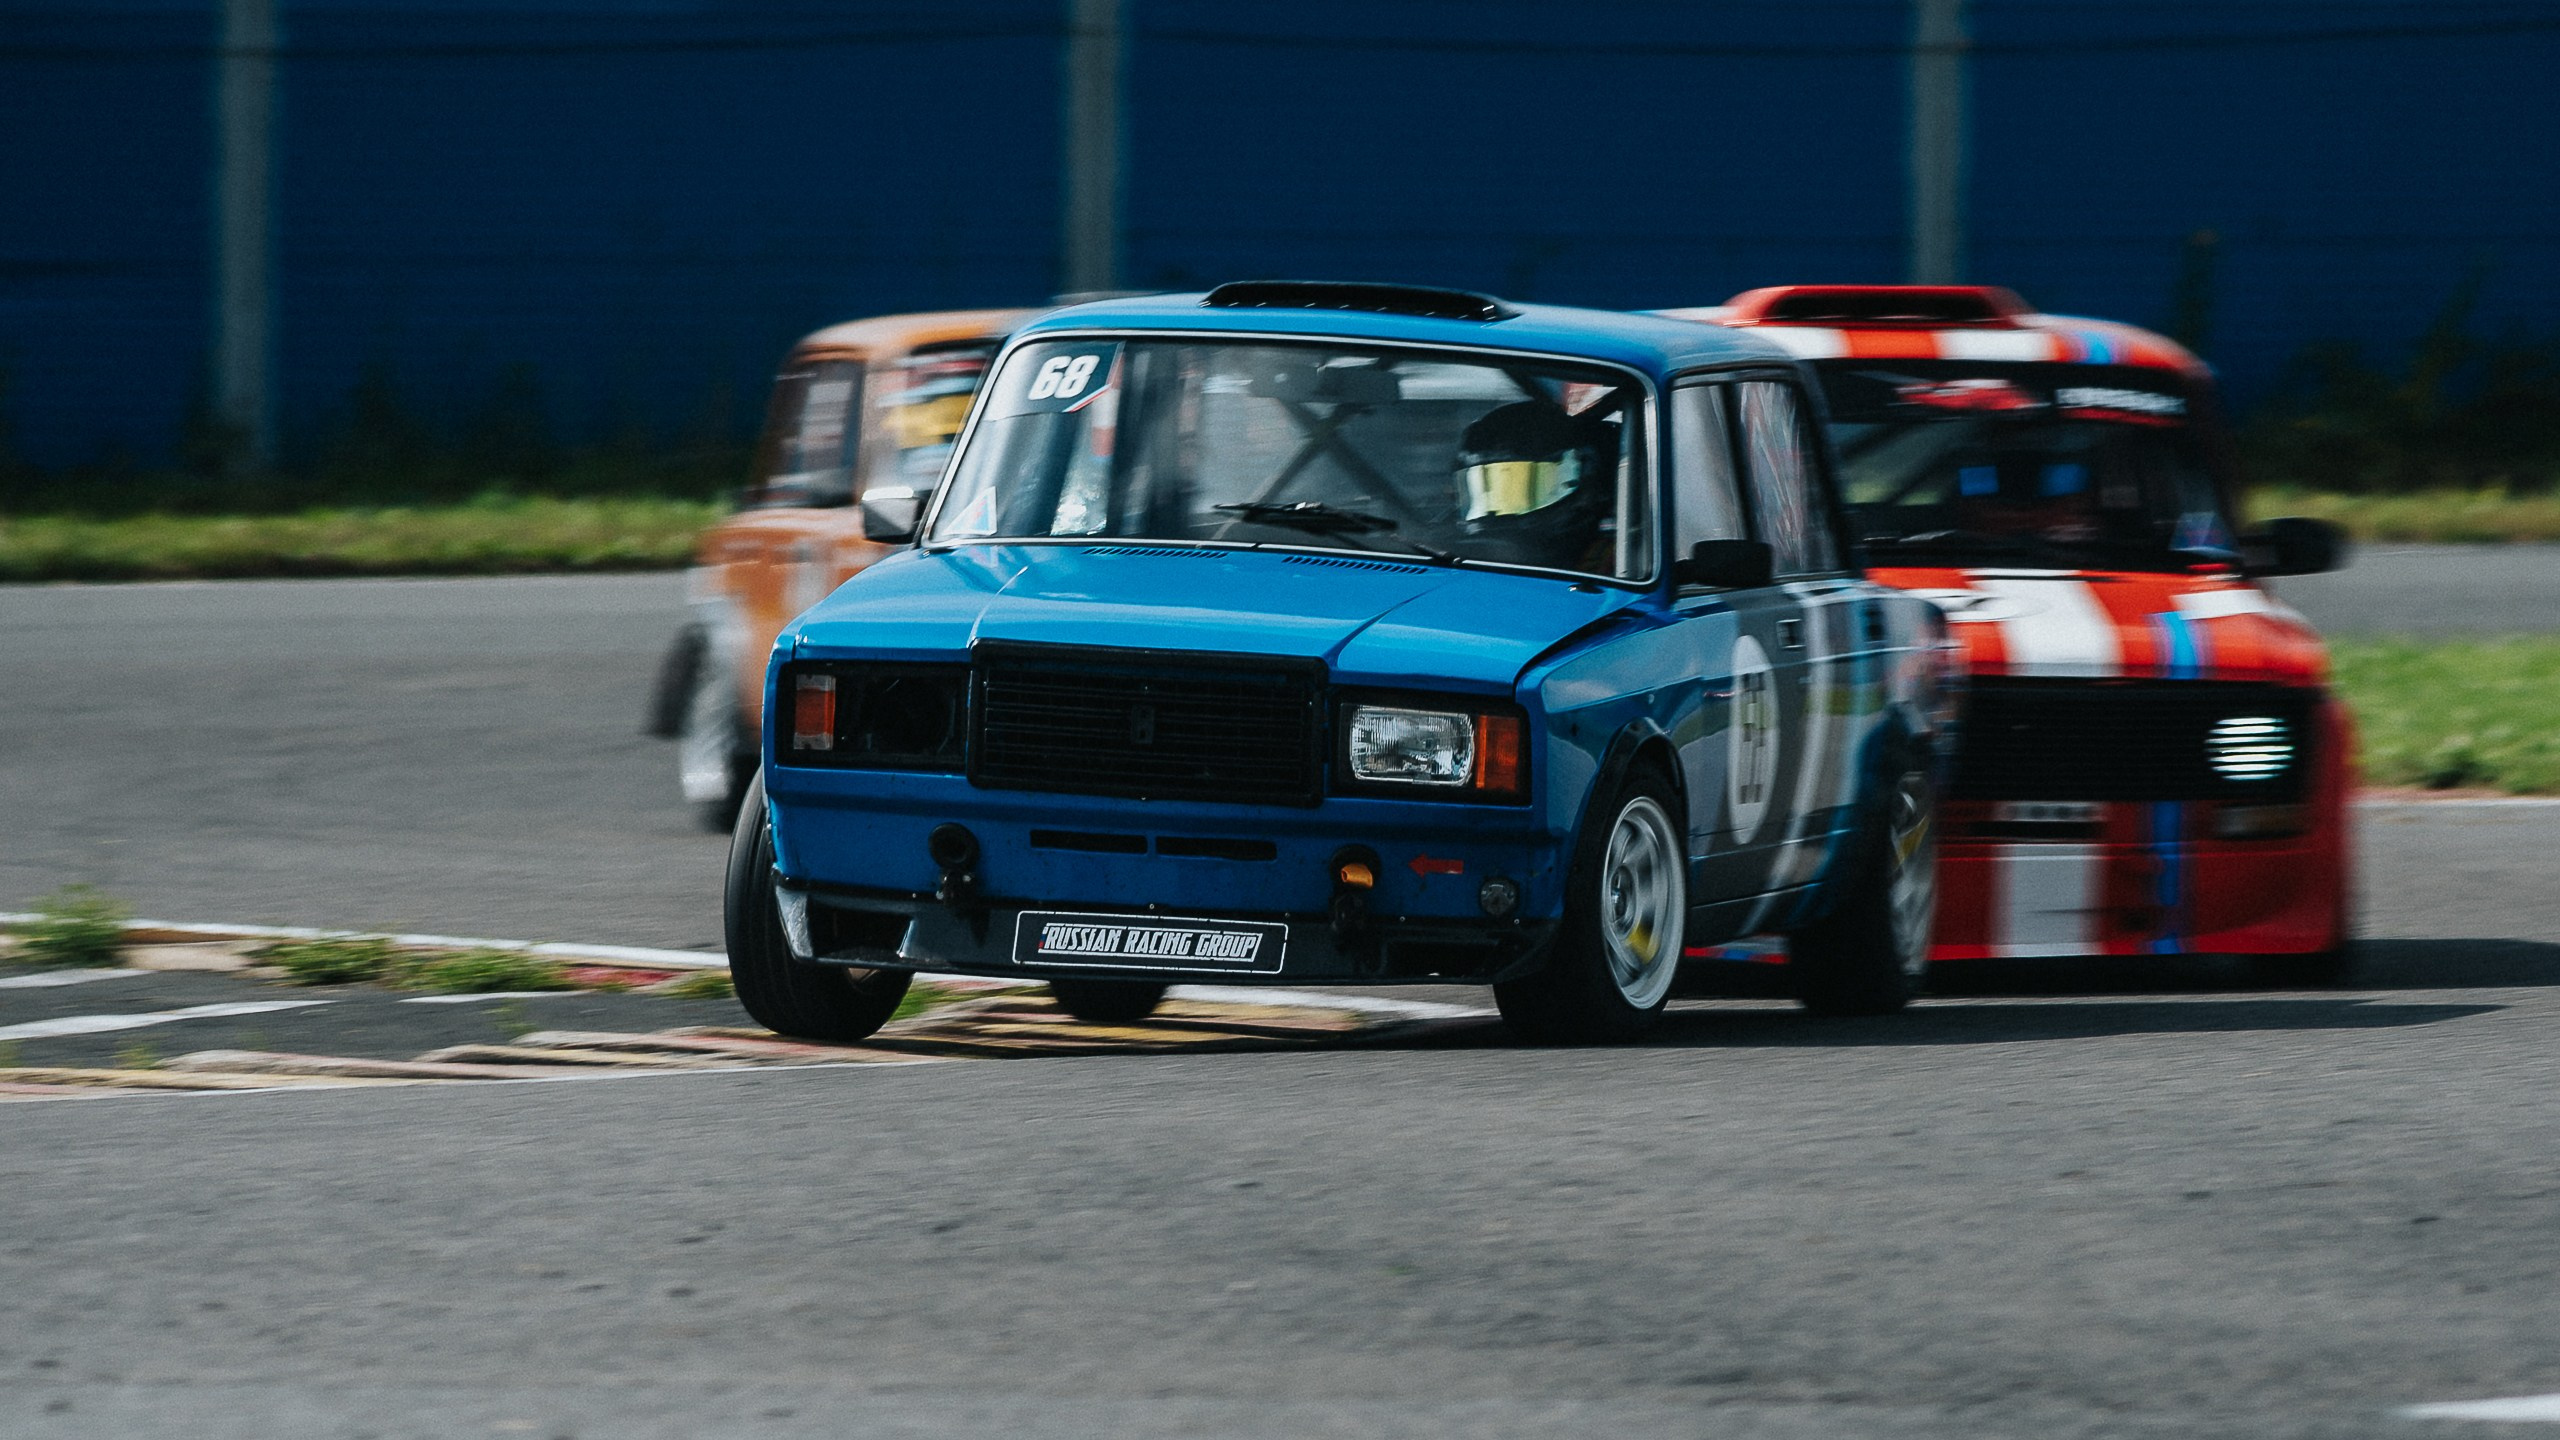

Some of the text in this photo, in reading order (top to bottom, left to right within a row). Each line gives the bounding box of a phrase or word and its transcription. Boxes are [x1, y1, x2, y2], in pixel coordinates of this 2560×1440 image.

[1028, 355, 1100, 400] 68
[1043, 926, 1259, 958] RUSSIAN RACING GROUP
